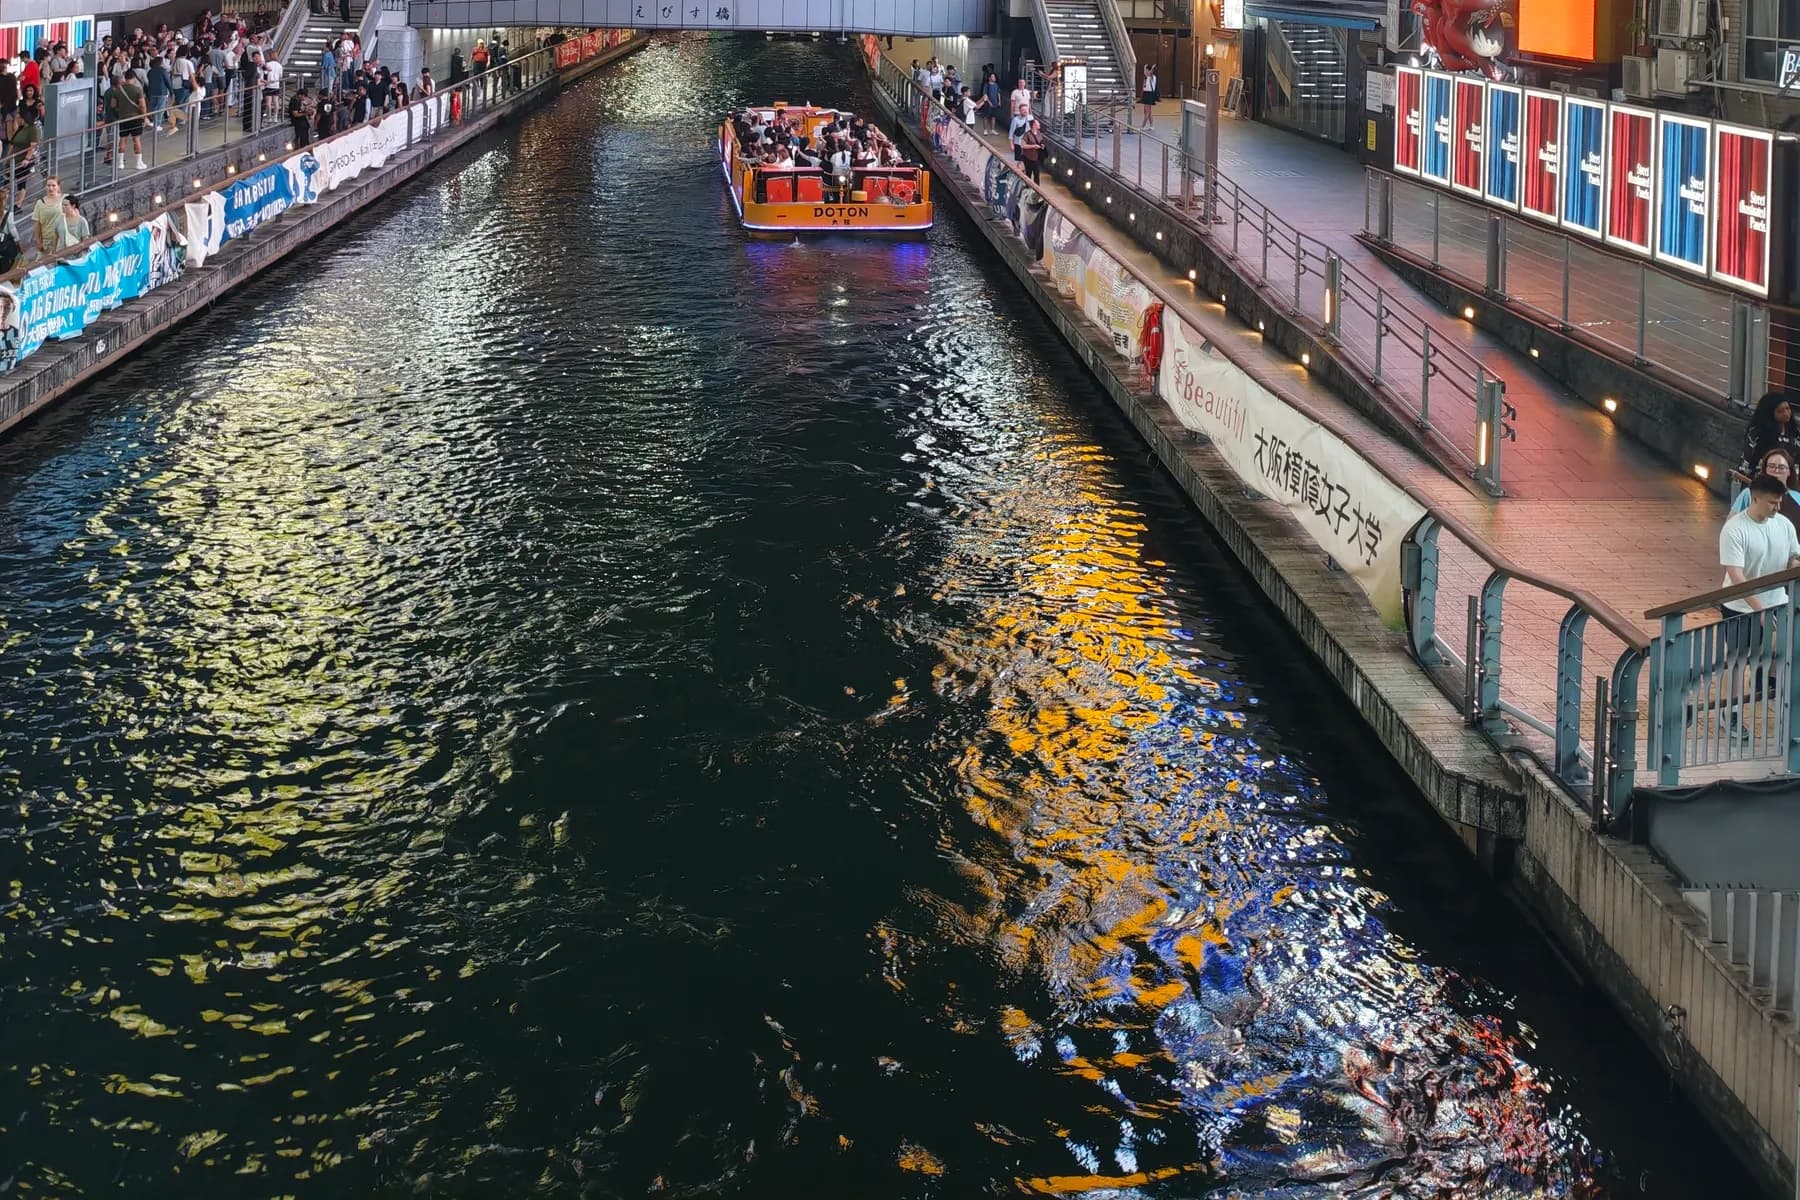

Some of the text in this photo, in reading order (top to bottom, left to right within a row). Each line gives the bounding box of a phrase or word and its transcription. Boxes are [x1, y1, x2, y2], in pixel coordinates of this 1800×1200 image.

[634, 5, 730, 21] えびす橋
[813, 207, 868, 218] DOTON
